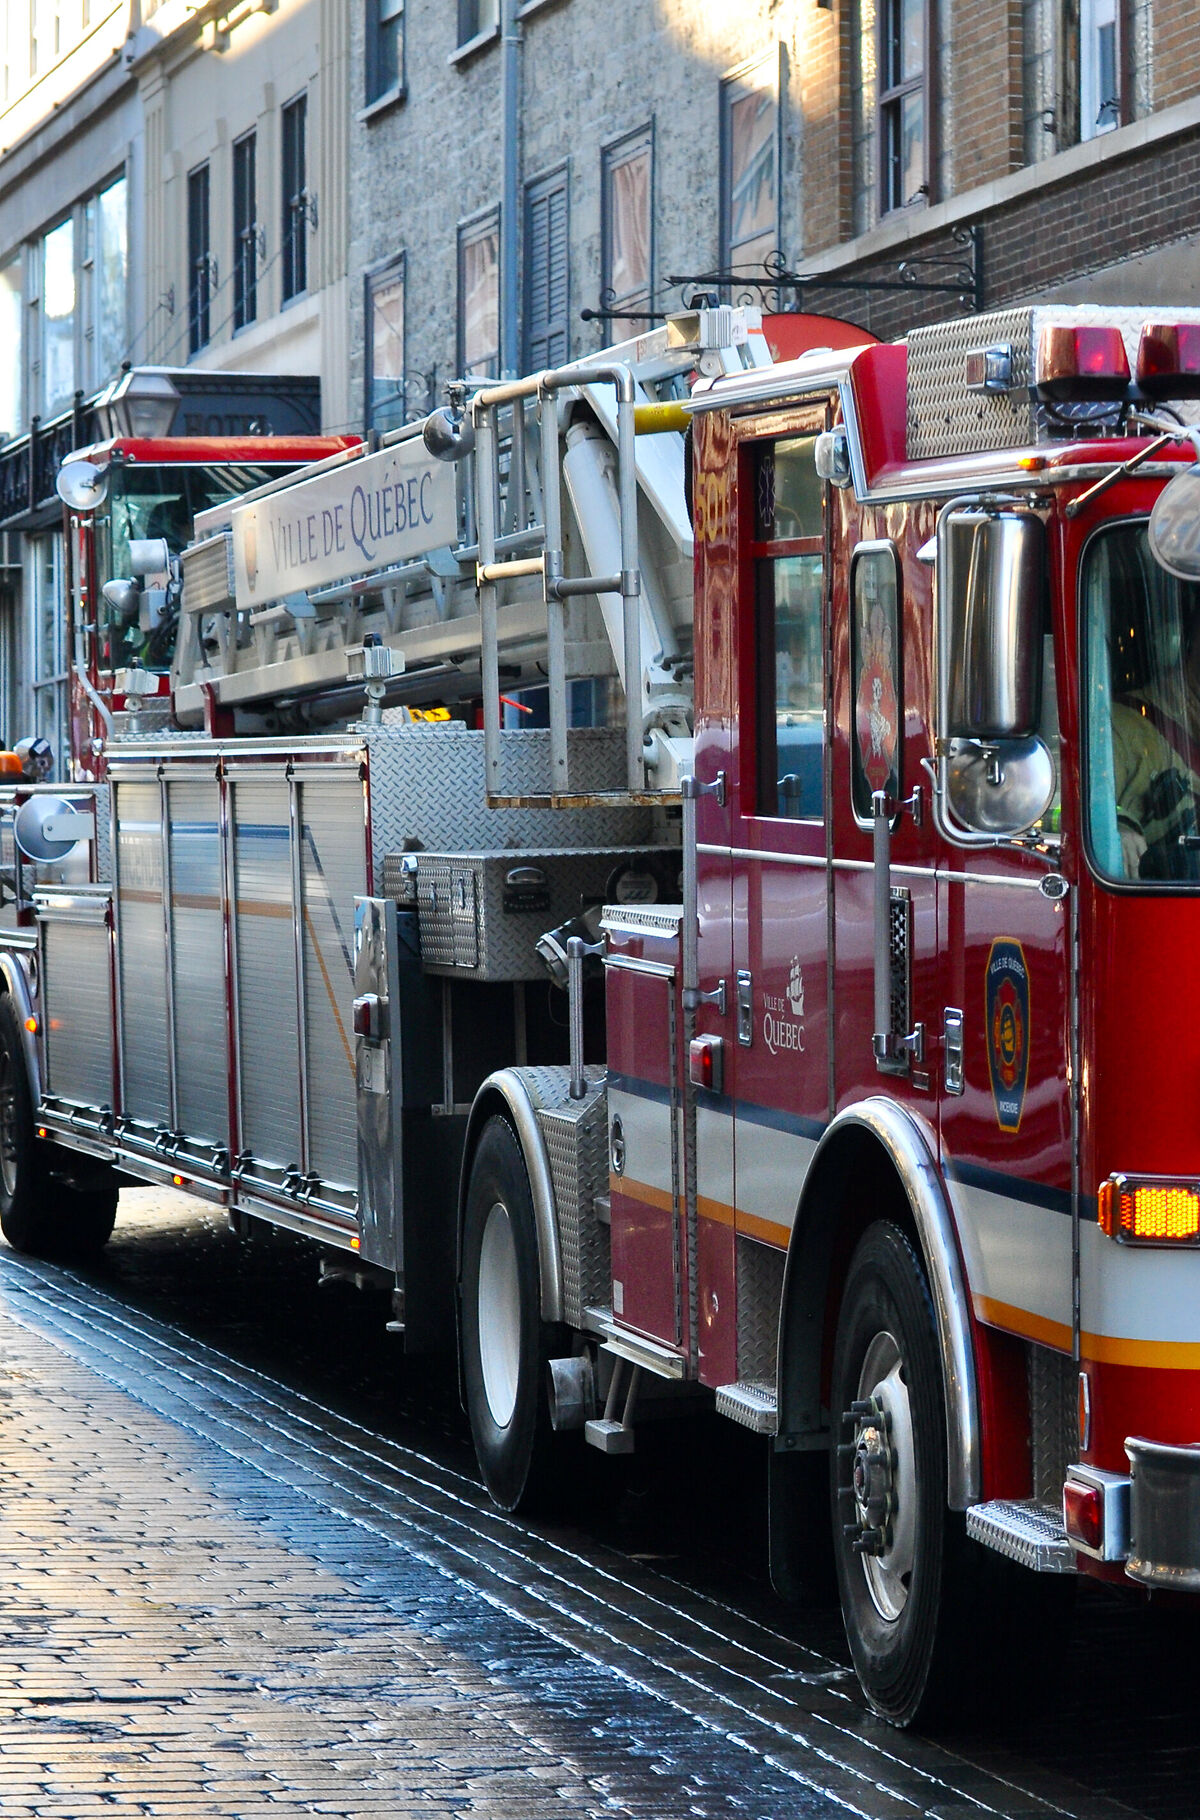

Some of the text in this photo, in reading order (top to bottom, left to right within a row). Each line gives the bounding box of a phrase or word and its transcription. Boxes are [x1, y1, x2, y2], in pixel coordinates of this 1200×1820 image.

[270, 471, 434, 573] VILLE DE QUÉBEC
[695, 471, 729, 543] 501
[763, 992, 785, 1012] VILLE DE
[763, 1012, 805, 1055] QUÉBEC
